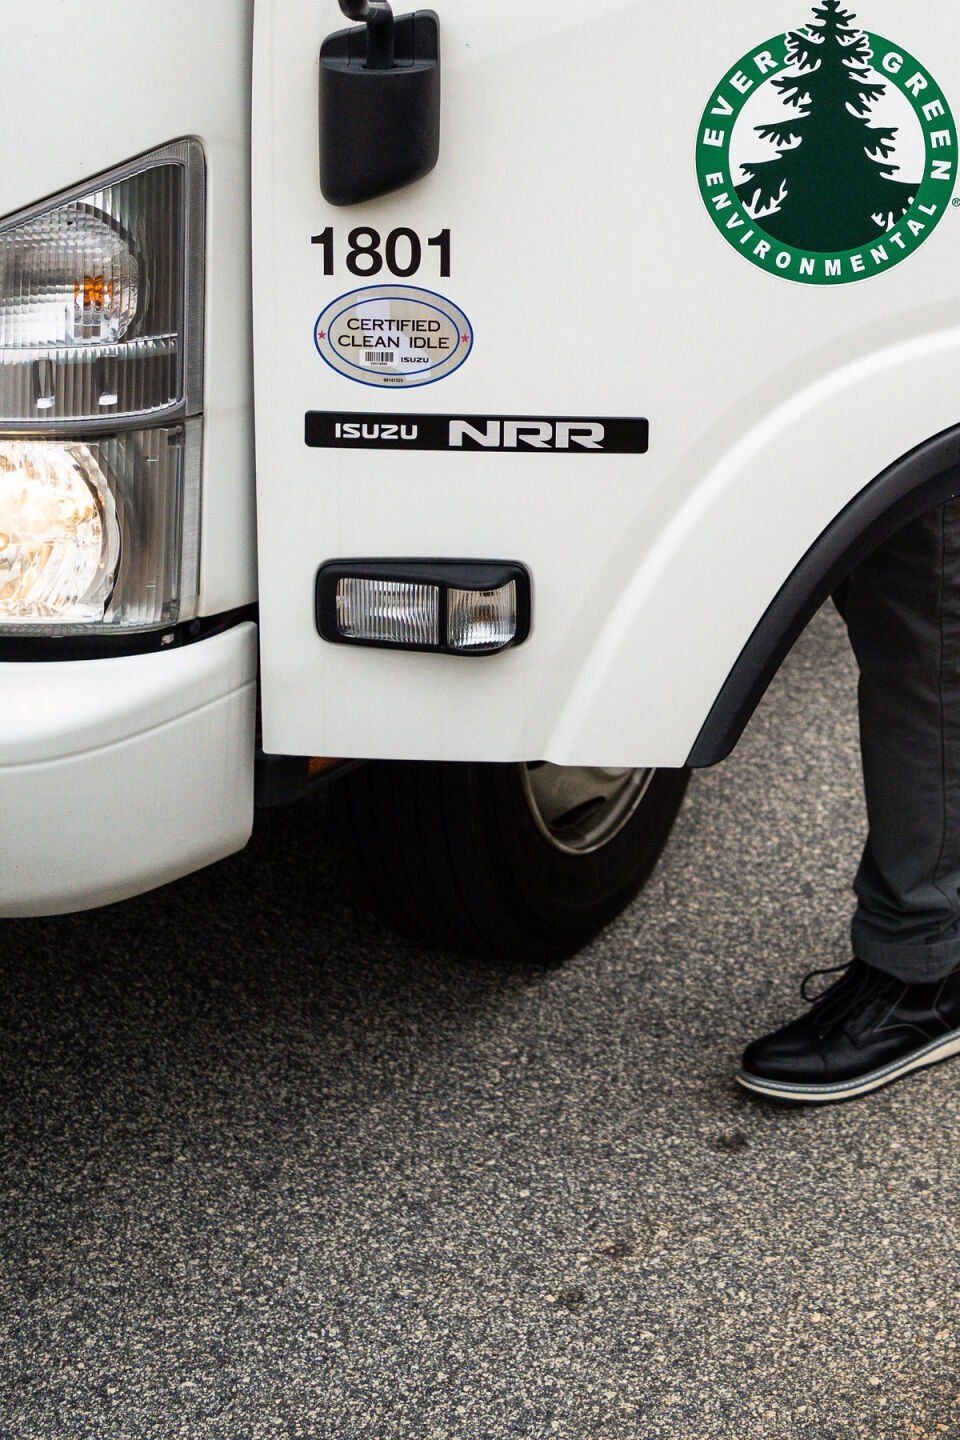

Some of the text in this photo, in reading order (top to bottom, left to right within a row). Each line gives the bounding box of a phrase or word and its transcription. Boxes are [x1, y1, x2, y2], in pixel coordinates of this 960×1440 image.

[703, 50, 952, 180] EVER GREEN
[705, 172, 937, 277] ENVIRONMENTAL
[310, 226, 451, 278] 1801
[346, 318, 441, 333] CERTIFIED
[338, 334, 450, 350] CLEAN IDLE
[400, 356, 430, 364] ISUZU
[335, 419, 605, 449] ISUZU NRR
